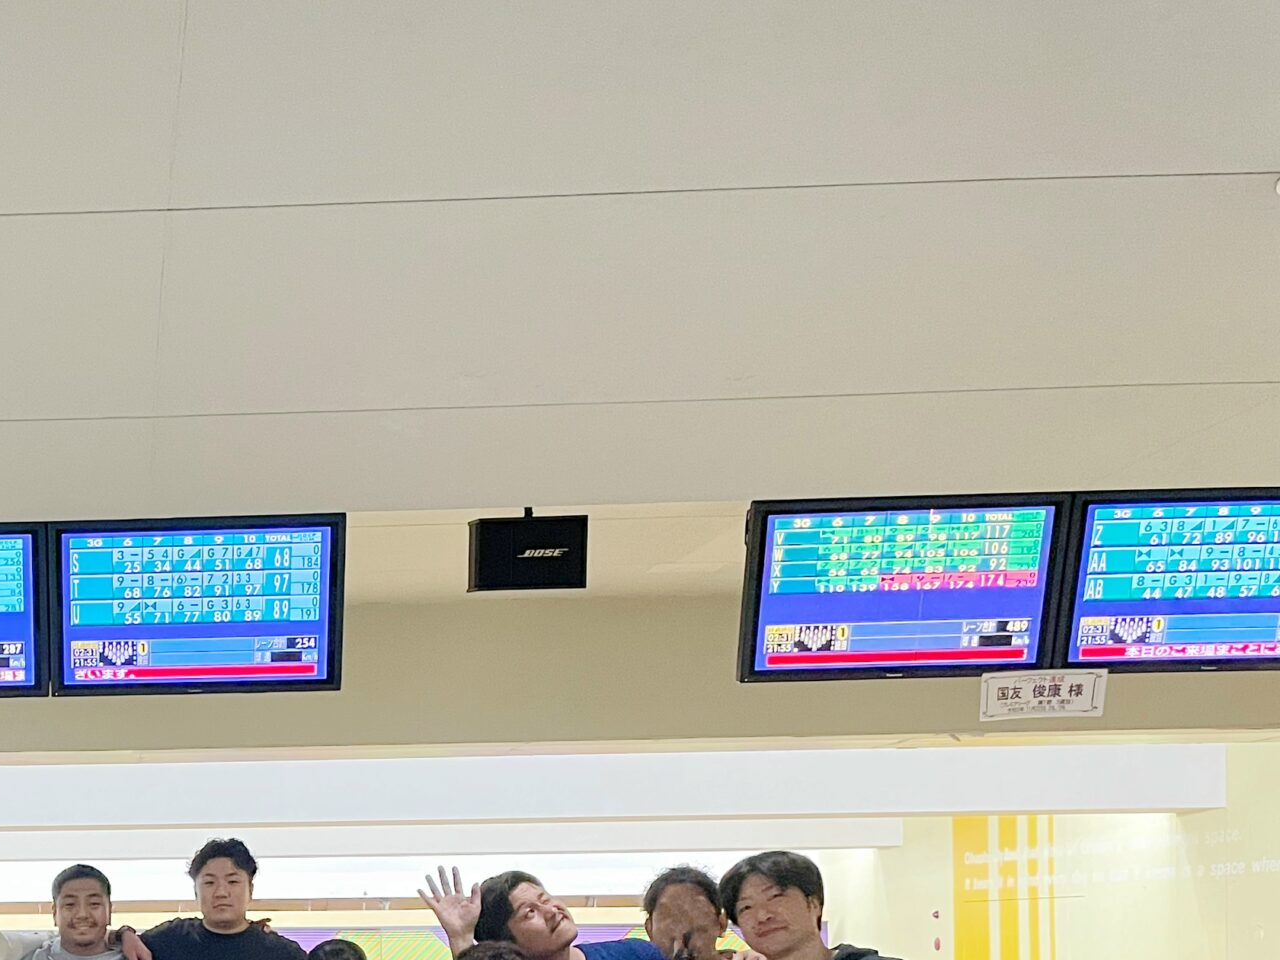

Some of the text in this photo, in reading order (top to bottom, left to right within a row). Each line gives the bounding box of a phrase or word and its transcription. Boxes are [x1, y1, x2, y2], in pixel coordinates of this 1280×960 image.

[1114, 510, 1130, 518] 3G
[1186, 508, 1196, 516] 7
[1218, 508, 1228, 516] 8
[986, 525, 1008, 538] 117
[1150, 534, 1166, 544] 61
[1182, 534, 1200, 543] 72
[1215, 533, 1232, 542] 89
[1248, 532, 1264, 542] 96
[517, 548, 568, 558] BOSE
[984, 542, 1007, 554] 106
[124, 563, 140, 572] 25
[155, 562, 170, 571] 34
[185, 562, 201, 571] 44
[215, 561, 230, 570] 51
[245, 560, 261, 569] 68
[274, 549, 290, 566] 68
[302, 557, 318, 567] 184
[990, 559, 1006, 570] 92
[1090, 552, 1260, 572] AA 65 84 93 101
[980, 574, 1004, 586] 174
[124, 588, 140, 598] 68
[154, 588, 170, 597] 76
[184, 587, 200, 596] 82
[214, 586, 230, 595] 91
[245, 586, 261, 595] 97
[274, 575, 289, 592] 97
[301, 583, 318, 593] 178
[1087, 579, 1256, 598] AB 44 47 48 57
[125, 614, 140, 624] 55
[154, 613, 170, 623] 71
[184, 613, 200, 622] 77
[214, 612, 230, 622] 80
[245, 611, 261, 621] 89
[273, 600, 289, 617] 89
[301, 609, 318, 618] 191
[1006, 622, 1028, 632] 489
[296, 638, 315, 647] 254
[4, 645, 21, 653] 287
[997, 683, 1084, 700] 国友 俊康 様
